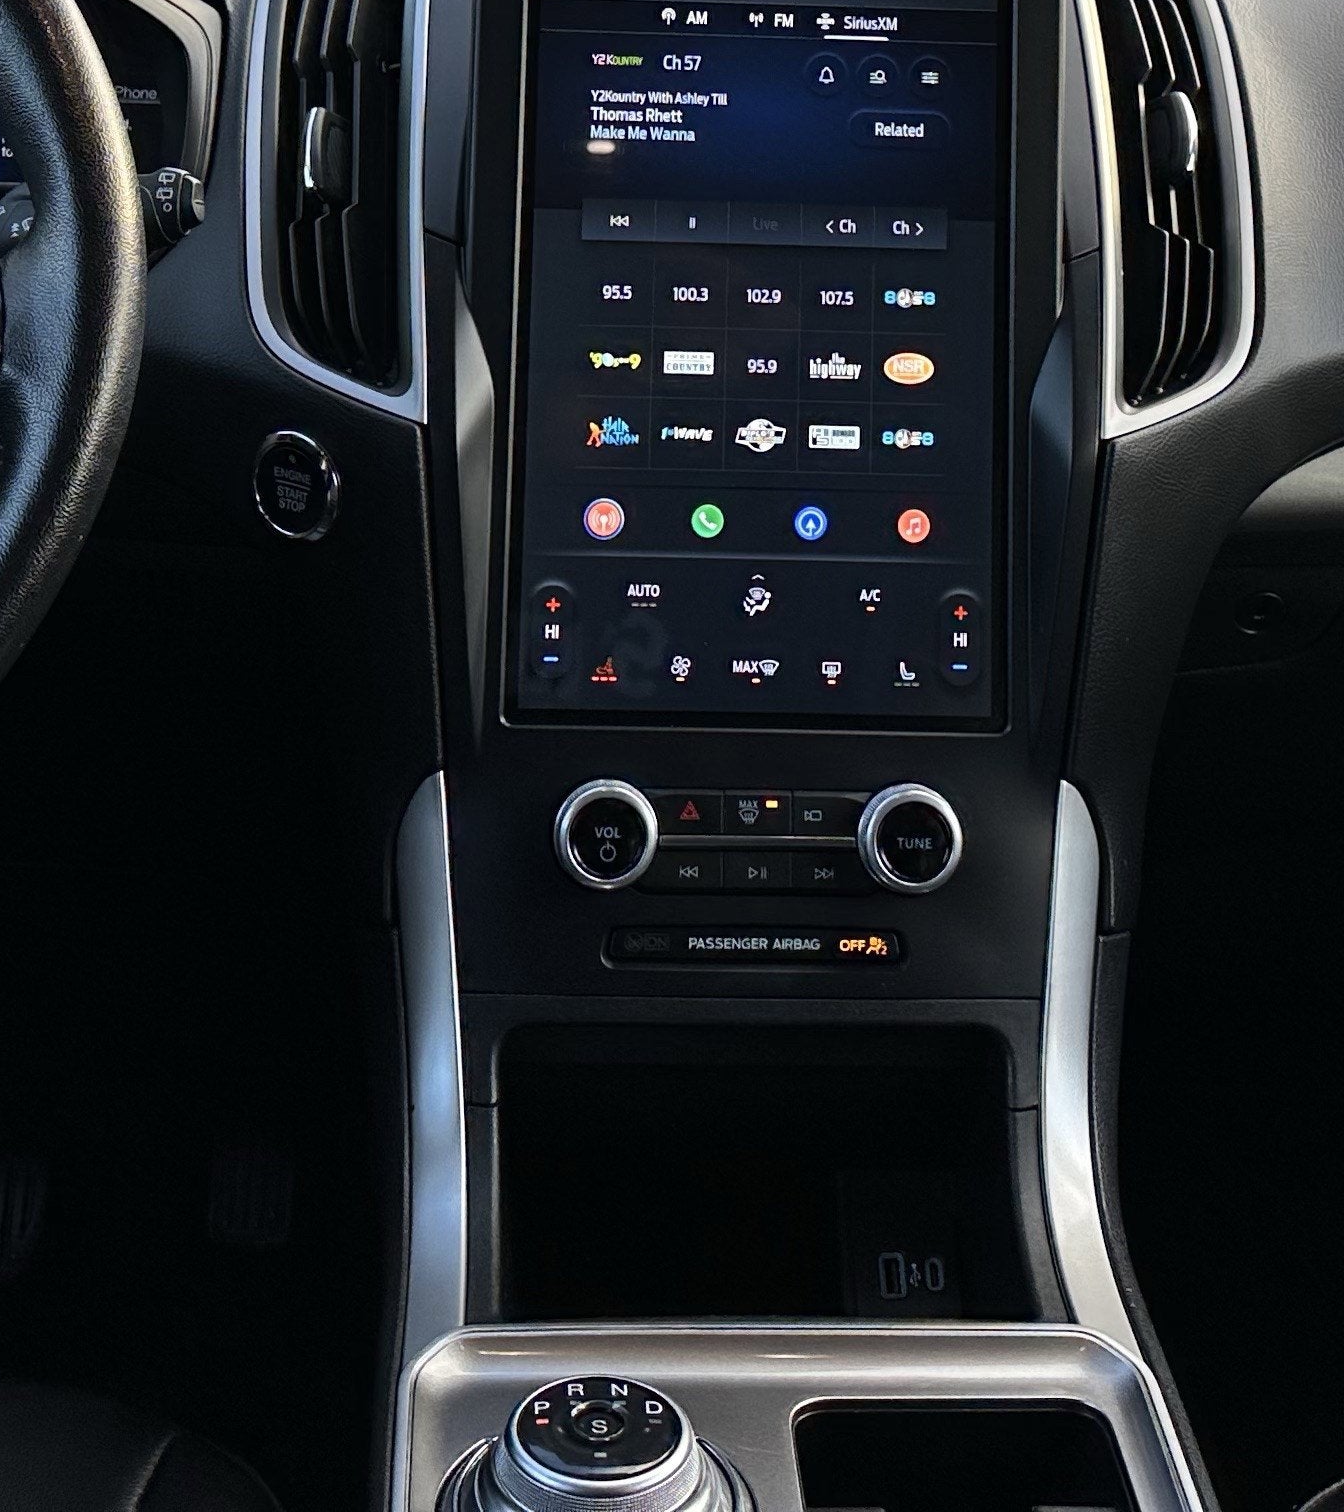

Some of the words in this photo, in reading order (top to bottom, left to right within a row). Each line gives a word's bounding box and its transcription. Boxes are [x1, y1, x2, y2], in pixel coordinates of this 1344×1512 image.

[686, 11, 709, 25] AM
[774, 13, 794, 29] FM
[843, 16, 898, 32] SiriusXM
[663, 55, 682, 71] Ch
[684, 55, 702, 71] 57
[591, 90, 646, 105] Y2Kountry
[648, 90, 673, 105] With
[675, 92, 709, 107] Ashley
[590, 106, 644, 122] Thomas
[646, 108, 683, 123] Rhett
[590, 124, 626, 139] Make
[628, 125, 648, 140] Me
[650, 126, 696, 141] Wanna
[875, 122, 925, 139] Related
[752, 217, 779, 232] Live
[839, 219, 856, 234] Ch
[892, 221, 910, 235] Ch
[602, 285, 633, 300] 95.5
[672, 286, 709, 302] 100.3
[746, 288, 782, 303] 102.9
[819, 290, 854, 305] 107.5
[666, 362, 712, 372] COUNTRY
[747, 358, 778, 374] 95.9
[809, 358, 862, 380] highway
[600, 432, 640, 446] NATION
[273, 466, 312, 486] ENGINE
[277, 486, 308, 502] START
[278, 497, 306, 513] STOP
[627, 584, 660, 598] AUTO
[859, 589, 881, 603] A/C
[545, 625, 560, 640] HI
[953, 633, 968, 648] HI
[732, 660, 759, 674] MAX
[738, 800, 758, 809] MAX
[594, 826, 621, 840] VOL
[897, 837, 933, 850] TUNE
[688, 937, 768, 951] PASSENGER
[772, 937, 821, 951] AIRBAG
[839, 939, 866, 953] OFF
[567, 1383, 584, 1397] R
[611, 1383, 629, 1397] N
[534, 1401, 550, 1415] P
[645, 1400, 664, 1414] D
[591, 1419, 609, 1434] S
